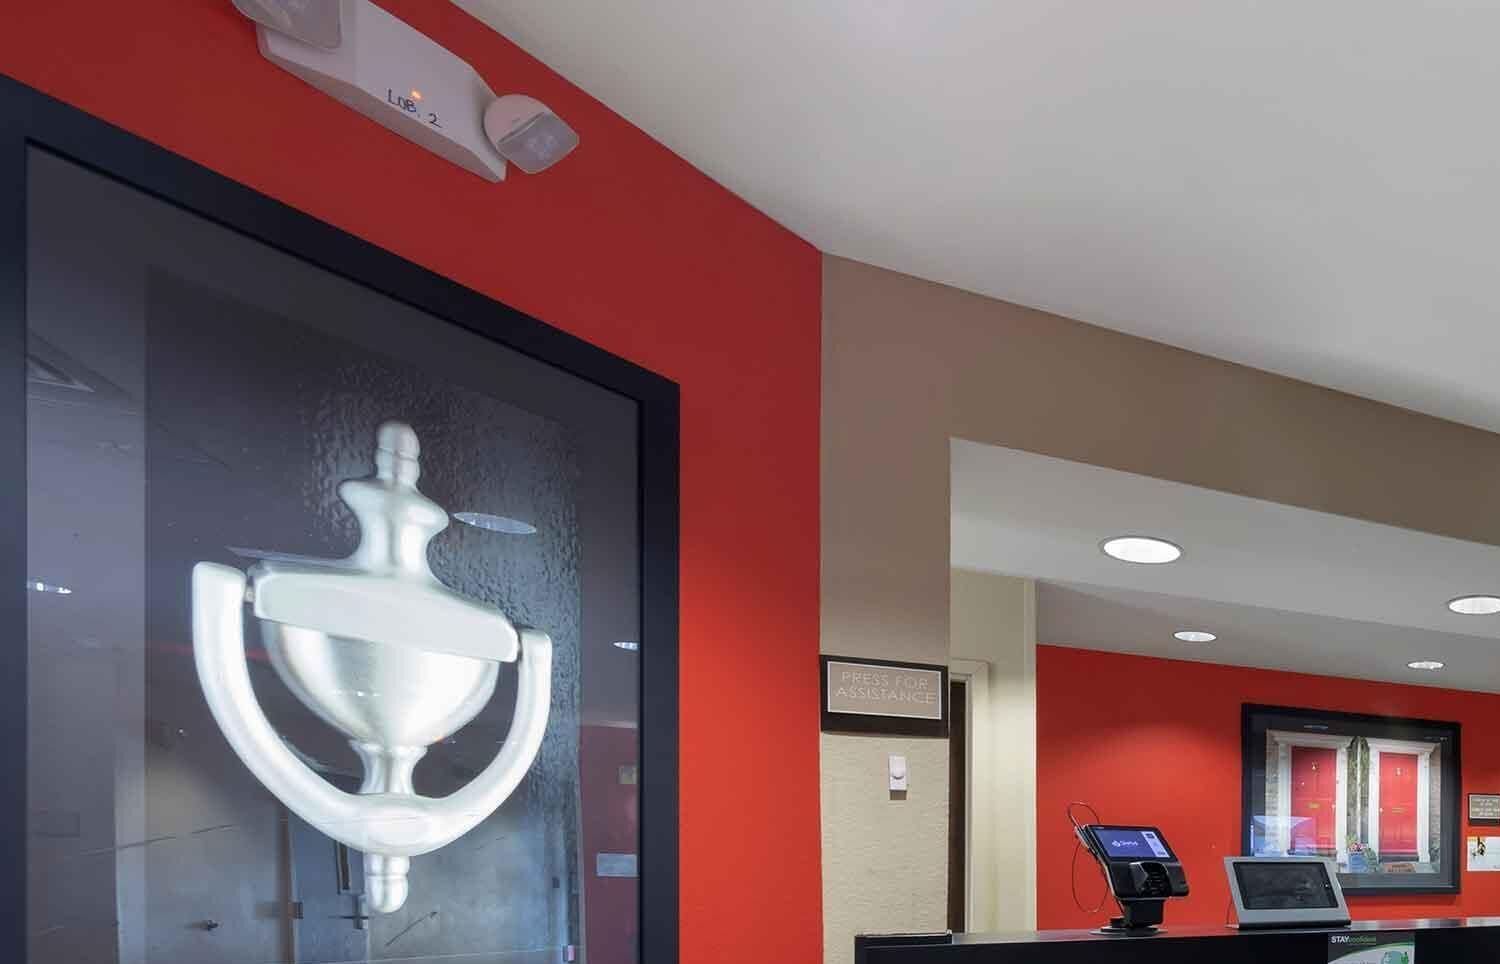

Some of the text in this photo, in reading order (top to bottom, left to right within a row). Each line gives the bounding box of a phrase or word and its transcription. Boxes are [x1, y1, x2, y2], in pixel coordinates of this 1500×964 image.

[428, 112, 443, 128] 2
[842, 671, 928, 690] PRESS FOR
[835, 686, 937, 704] ASSISTANCE
